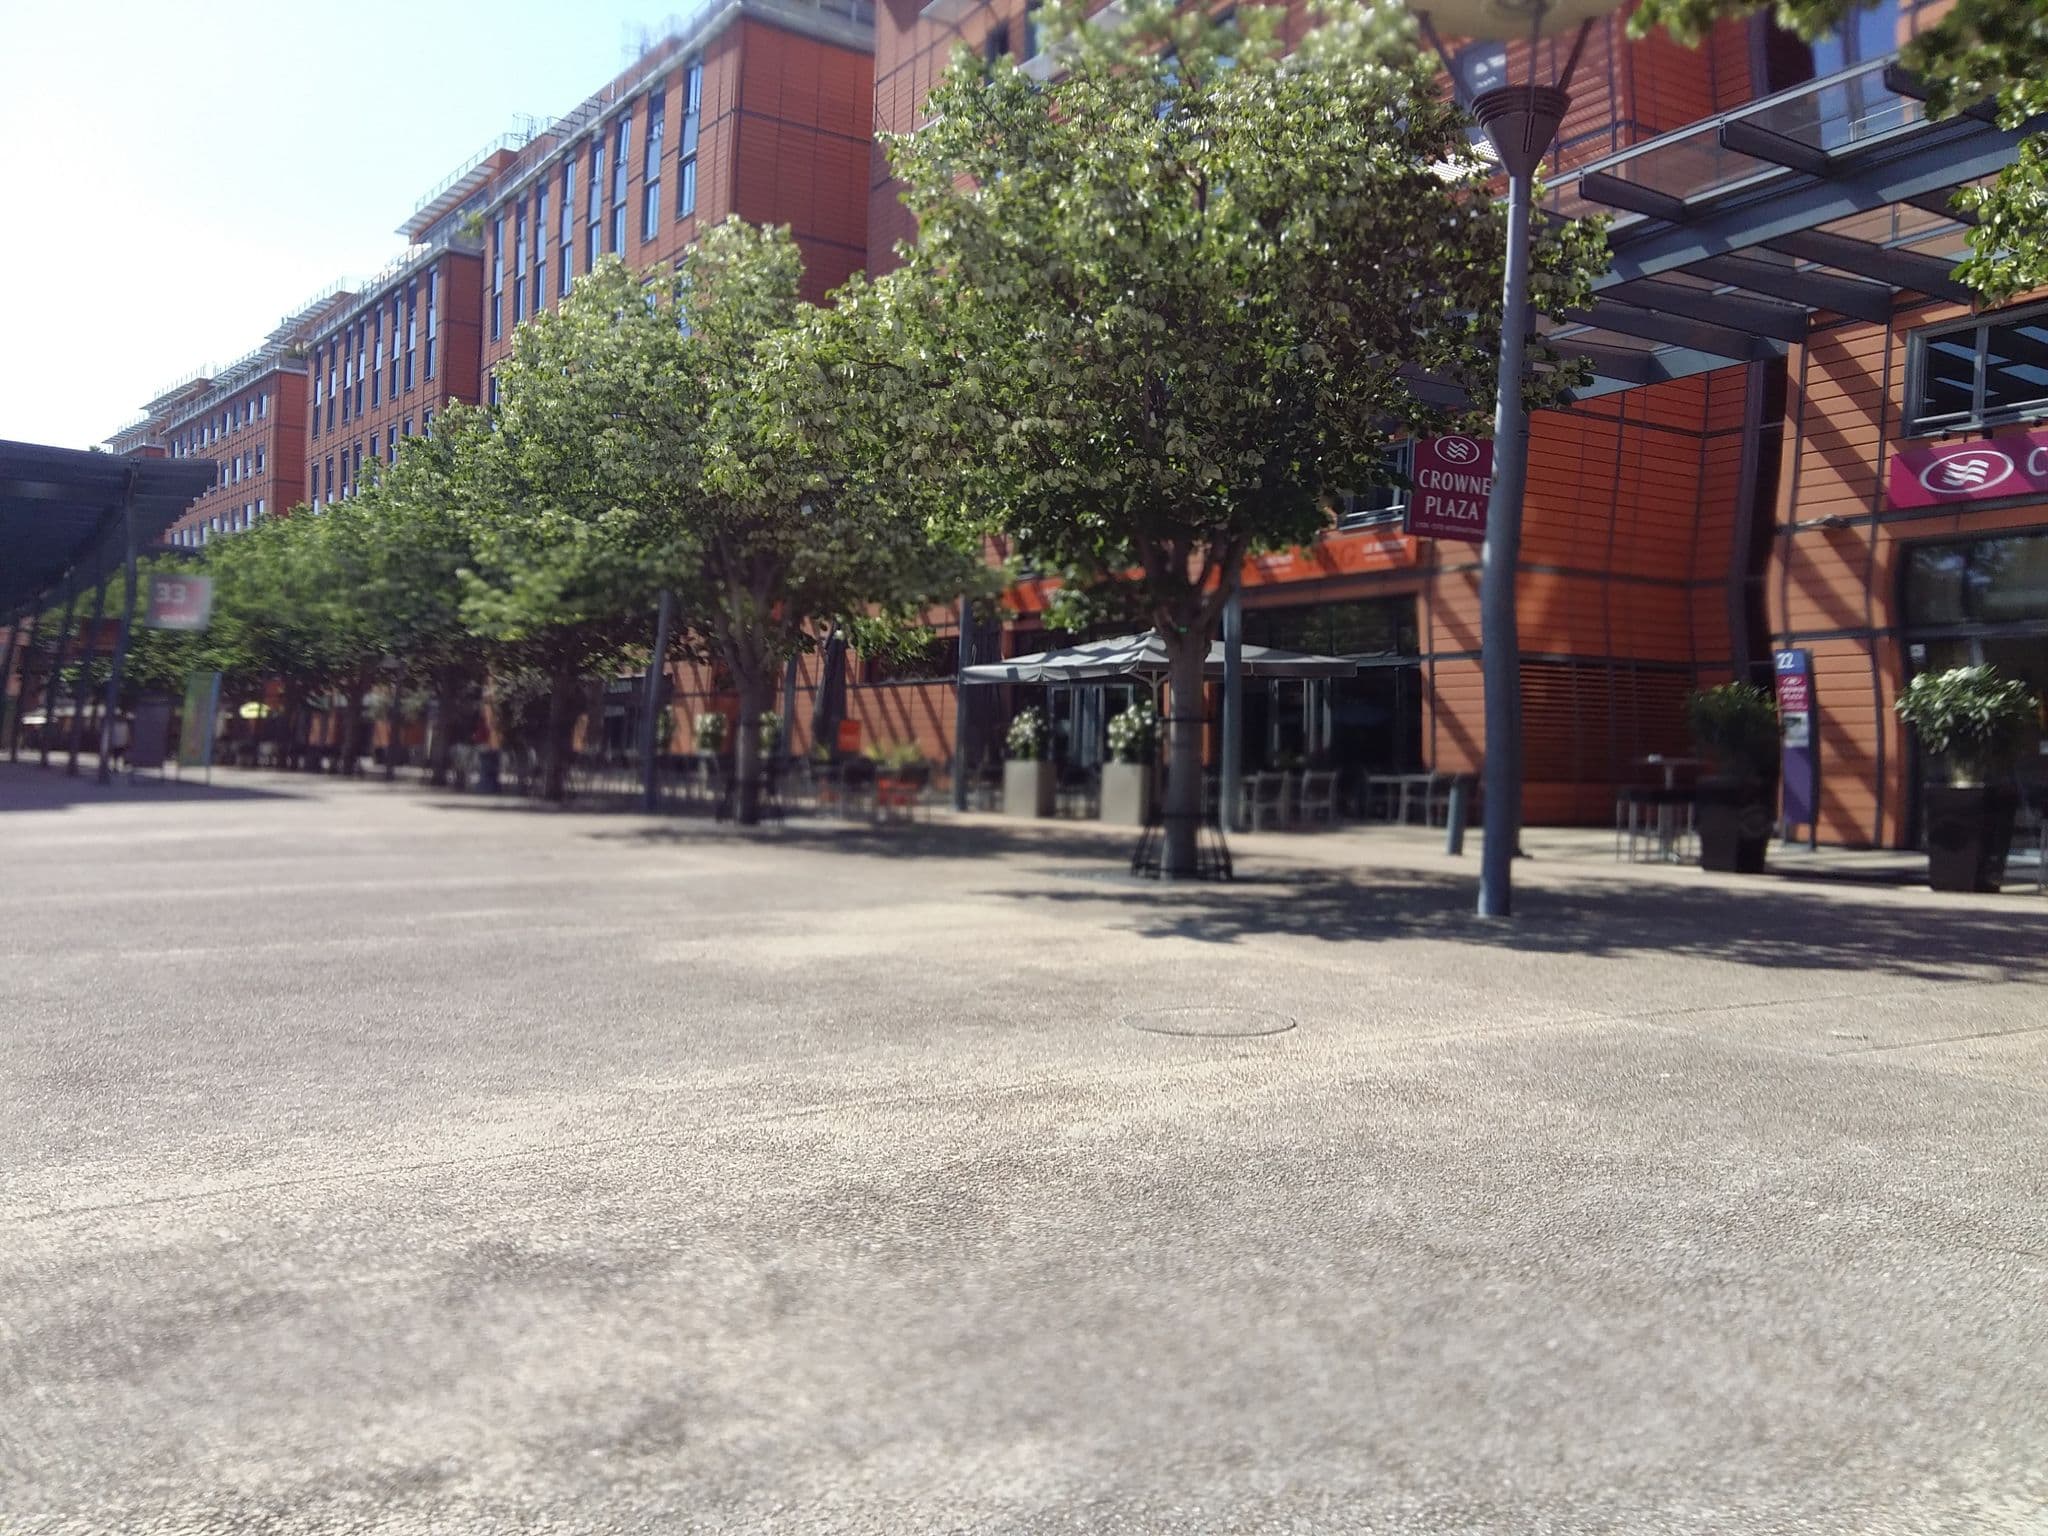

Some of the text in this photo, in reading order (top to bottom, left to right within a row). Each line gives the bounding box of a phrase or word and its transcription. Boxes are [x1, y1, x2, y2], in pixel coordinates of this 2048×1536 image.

[1418, 468, 1492, 497] CROWNE
[1425, 495, 1479, 520] PLAZA
[1776, 652, 1795, 669] 22
